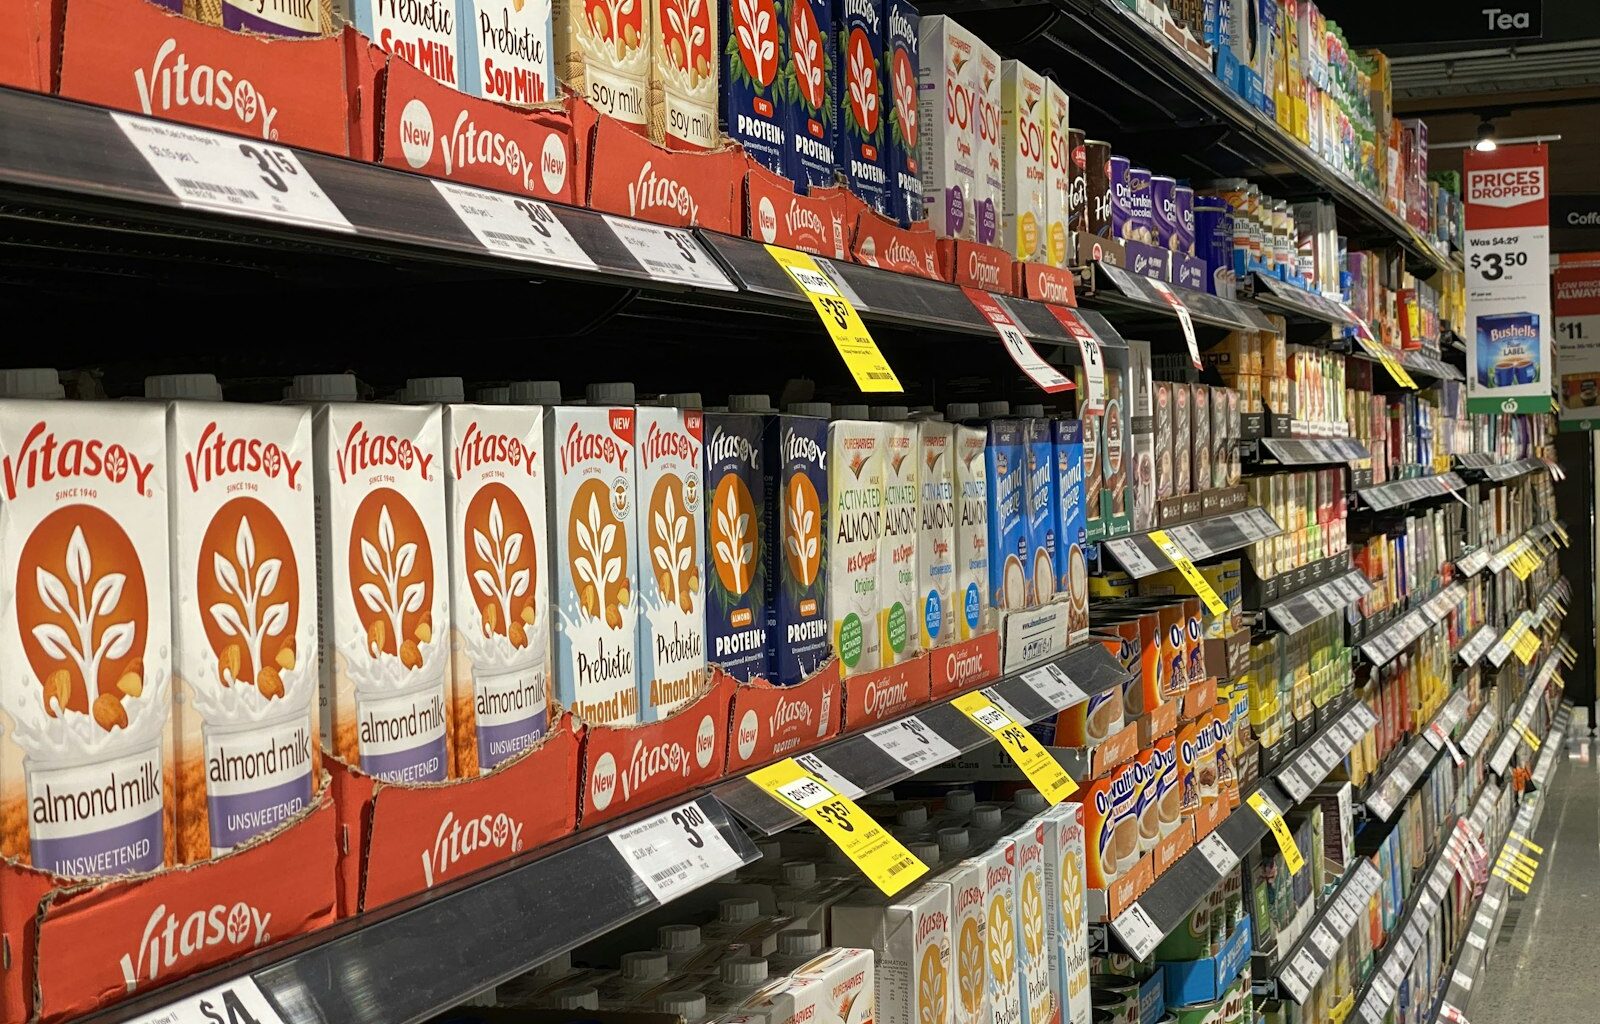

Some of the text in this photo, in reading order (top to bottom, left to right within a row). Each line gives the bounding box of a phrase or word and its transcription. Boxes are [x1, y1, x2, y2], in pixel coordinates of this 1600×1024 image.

[480, 7, 545, 65] Prebiotic
[889, 4, 918, 54] Vitasoy
[1481, 8, 1530, 31] Tea
[134, 38, 278, 140] Vitasoy
[484, 57, 546, 104] Soy Milk
[592, 82, 644, 117] soy milk
[947, 78, 976, 134] SOY
[403, 121, 431, 148] New
[670, 108, 713, 141] soy milk
[440, 109, 535, 192] Vitasoy
[542, 158, 564, 176] New
[628, 160, 699, 226] Vitasoy
[1471, 170, 1541, 189] PRICES
[1471, 185, 1541, 200] DROPPED
[758, 211, 776, 231] New
[785, 198, 827, 244] Vitasoy
[1470, 236, 1519, 247] Was $4.29
[968, 251, 1000, 289] Organic
[1038, 271, 1068, 302] Organic
[1557, 282, 1578, 290] LOW
[1490, 324, 1537, 342] Bushells
[1560, 321, 1583, 340] $11
[1503, 346, 1525, 356] LABEL
[613, 417, 631, 430] NEW
[687, 416, 701, 430] NEW
[3, 421, 155, 501] Vitasoy
[185, 421, 303, 493] Vitasoy
[336, 421, 434, 485] Vitasoy
[455, 421, 537, 481] Vitasoy
[560, 422, 629, 476] Vitasoy
[641, 421, 699, 471] Vitasoy
[706, 425, 759, 472] Vitasoy
[781, 427, 827, 471] Vitasoy
[55, 487, 98, 501] SINCE 1940
[226, 481, 259, 494] SINCE 1940
[368, 474, 396, 486] SINCE 1940
[481, 470, 494, 481] SINCE
[838, 488, 881, 511] ACTIVATED
[921, 502, 954, 531] ALMOND
[837, 511, 881, 545] ALMOND
[884, 507, 917, 537] ALMOND
[656, 620, 702, 667] Prebiotic
[715, 628, 767, 657] PROTEIN+
[576, 636, 633, 687] Prebiotic
[946, 645, 983, 688] Organic
[476, 672, 546, 716] almond milk
[650, 671, 691, 708] Almond
[864, 672, 909, 720] Organic
[361, 694, 445, 744] almond milk
[769, 695, 813, 738] Vitasoy
[209, 727, 311, 783] almond milk
[489, 729, 541, 756] UNSWEETENED
[697, 734, 713, 750] New
[739, 728, 756, 747] New
[593, 775, 616, 793] New
[621, 739, 691, 802] Vitasoy
[33, 761, 161, 824] almond milk
[227, 796, 303, 832] UNSWEETENED
[55, 838, 150, 877] UNSWEETENED
[421, 811, 524, 888] Vitasoy
[986, 865, 1012, 895] Vitasoy
[955, 886, 985, 923] Vitasoy
[121, 902, 272, 993] Vitasoy
[916, 911, 949, 950] Vitasoy
[832, 970, 866, 1001] PUREHARVEST
